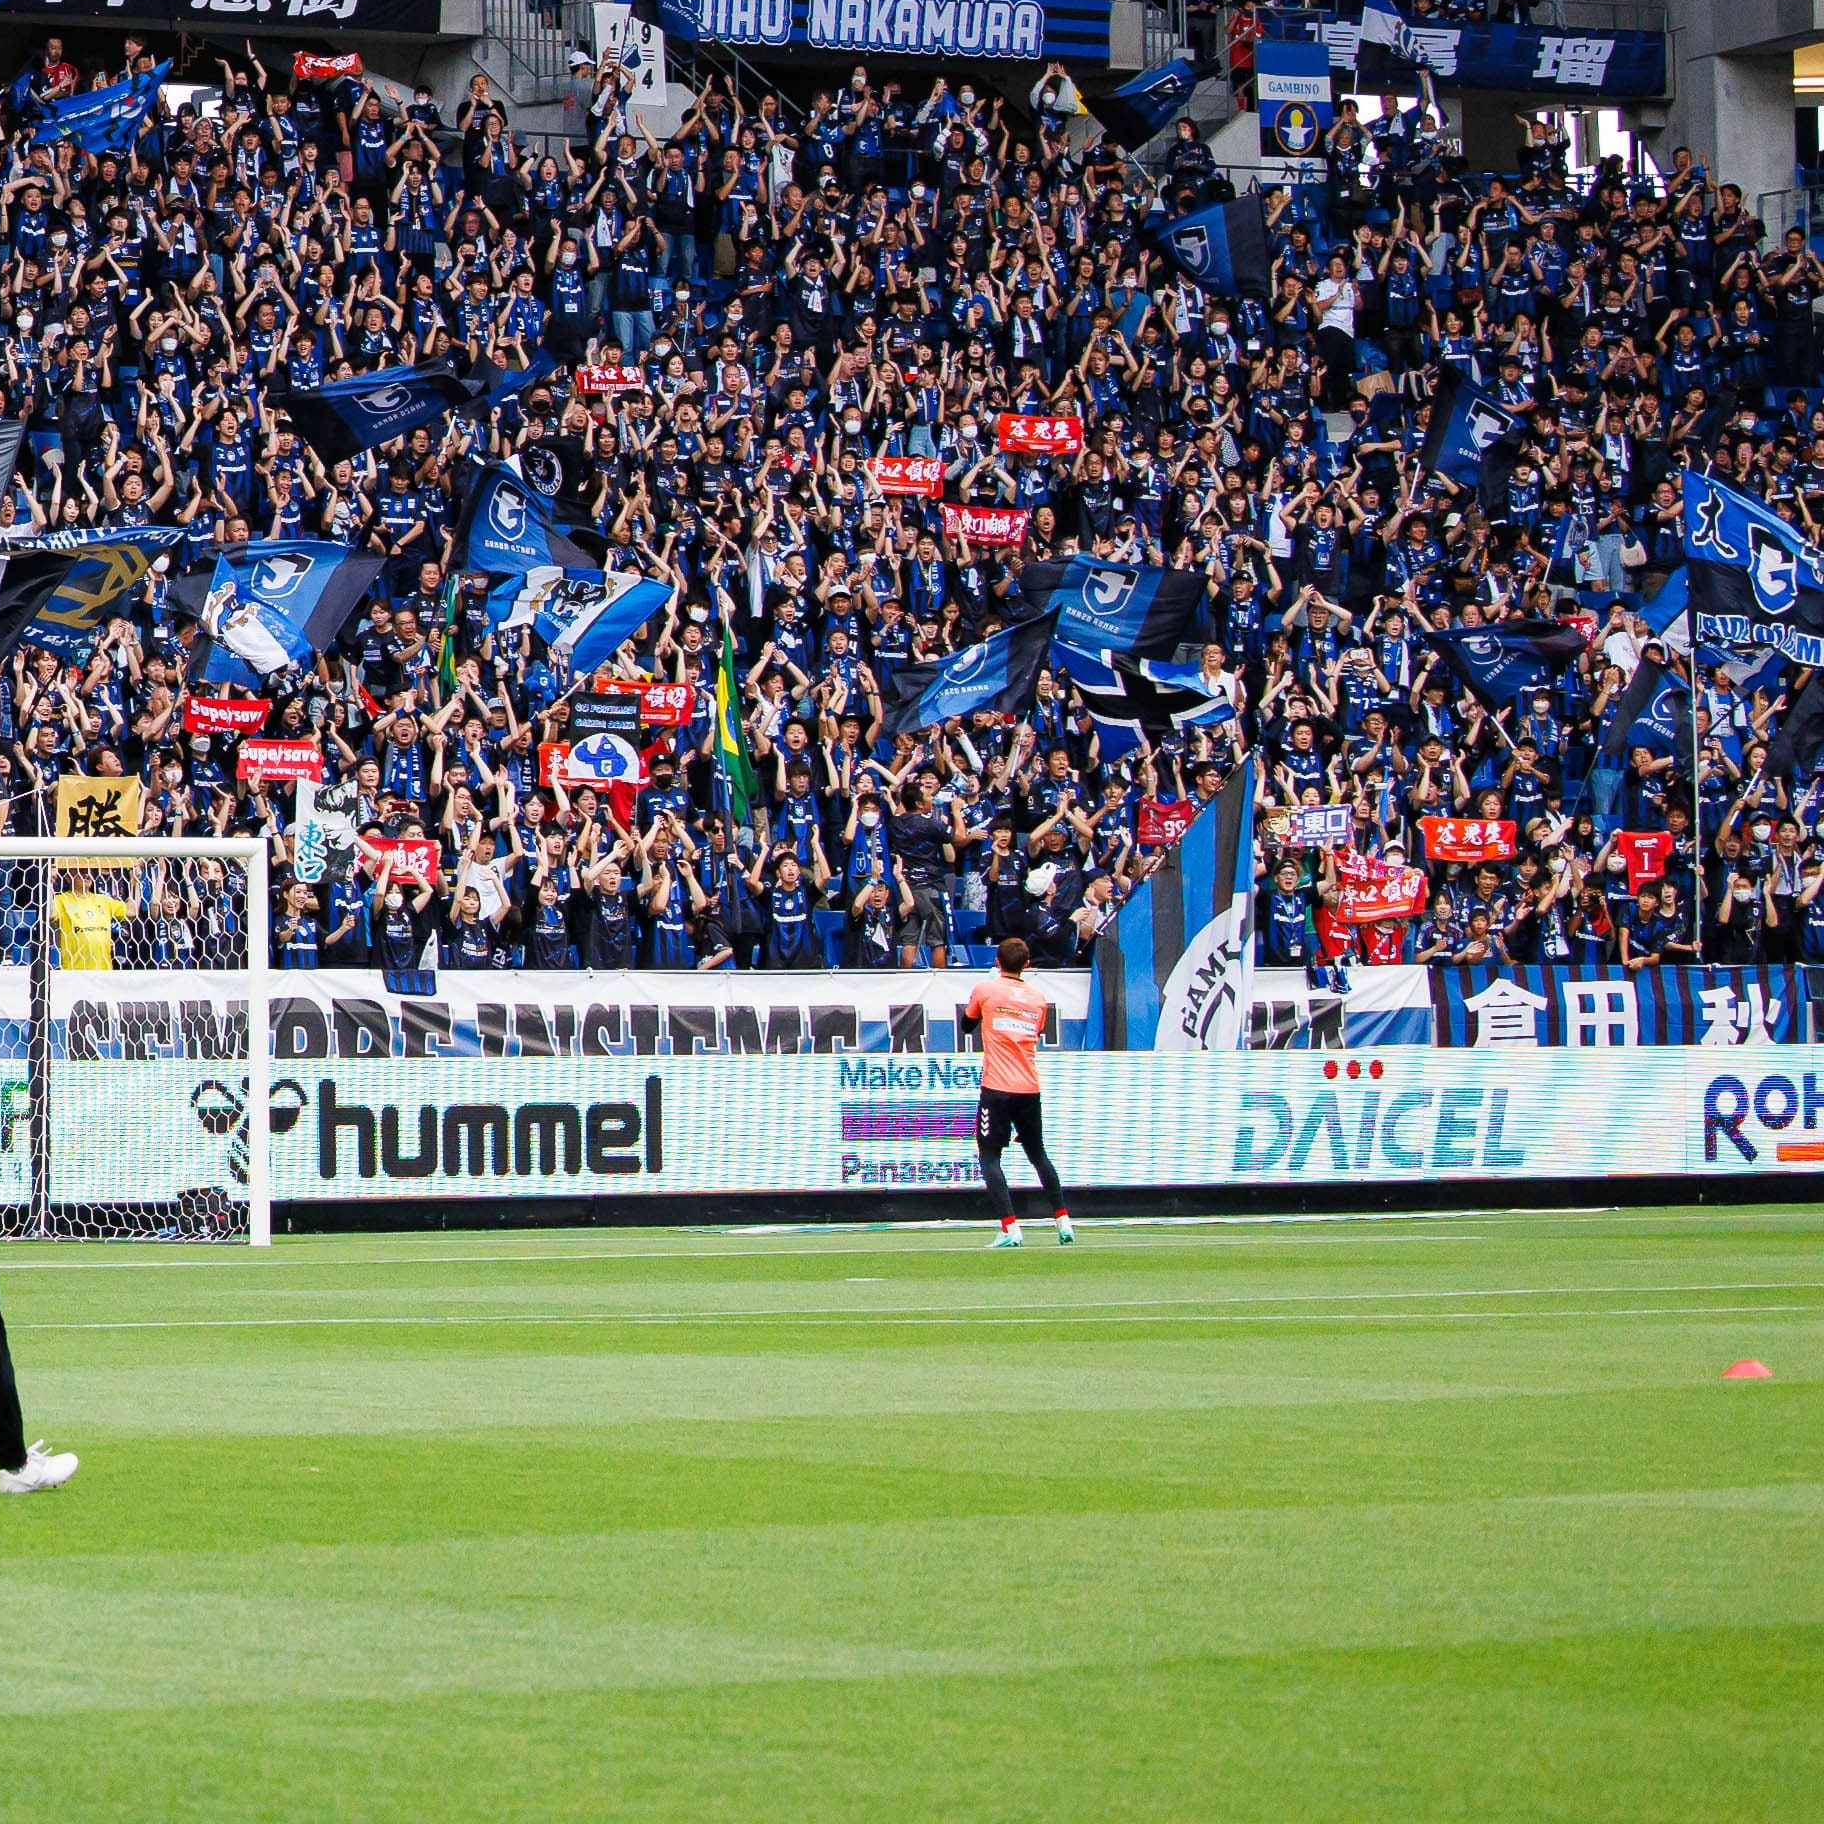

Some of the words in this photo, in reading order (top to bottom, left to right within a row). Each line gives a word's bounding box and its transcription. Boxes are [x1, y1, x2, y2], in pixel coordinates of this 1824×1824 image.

[641, 23, 652, 44] 9
[1267, 80, 1320, 94] GAMBINO
[1009, 420, 1073, 441] 谷晃生
[1300, 810, 1349, 841] 東口
[1433, 821, 1510, 848] 谷晃生
[840, 1058, 923, 1088] Make
[318, 1075, 663, 1179] hummel
